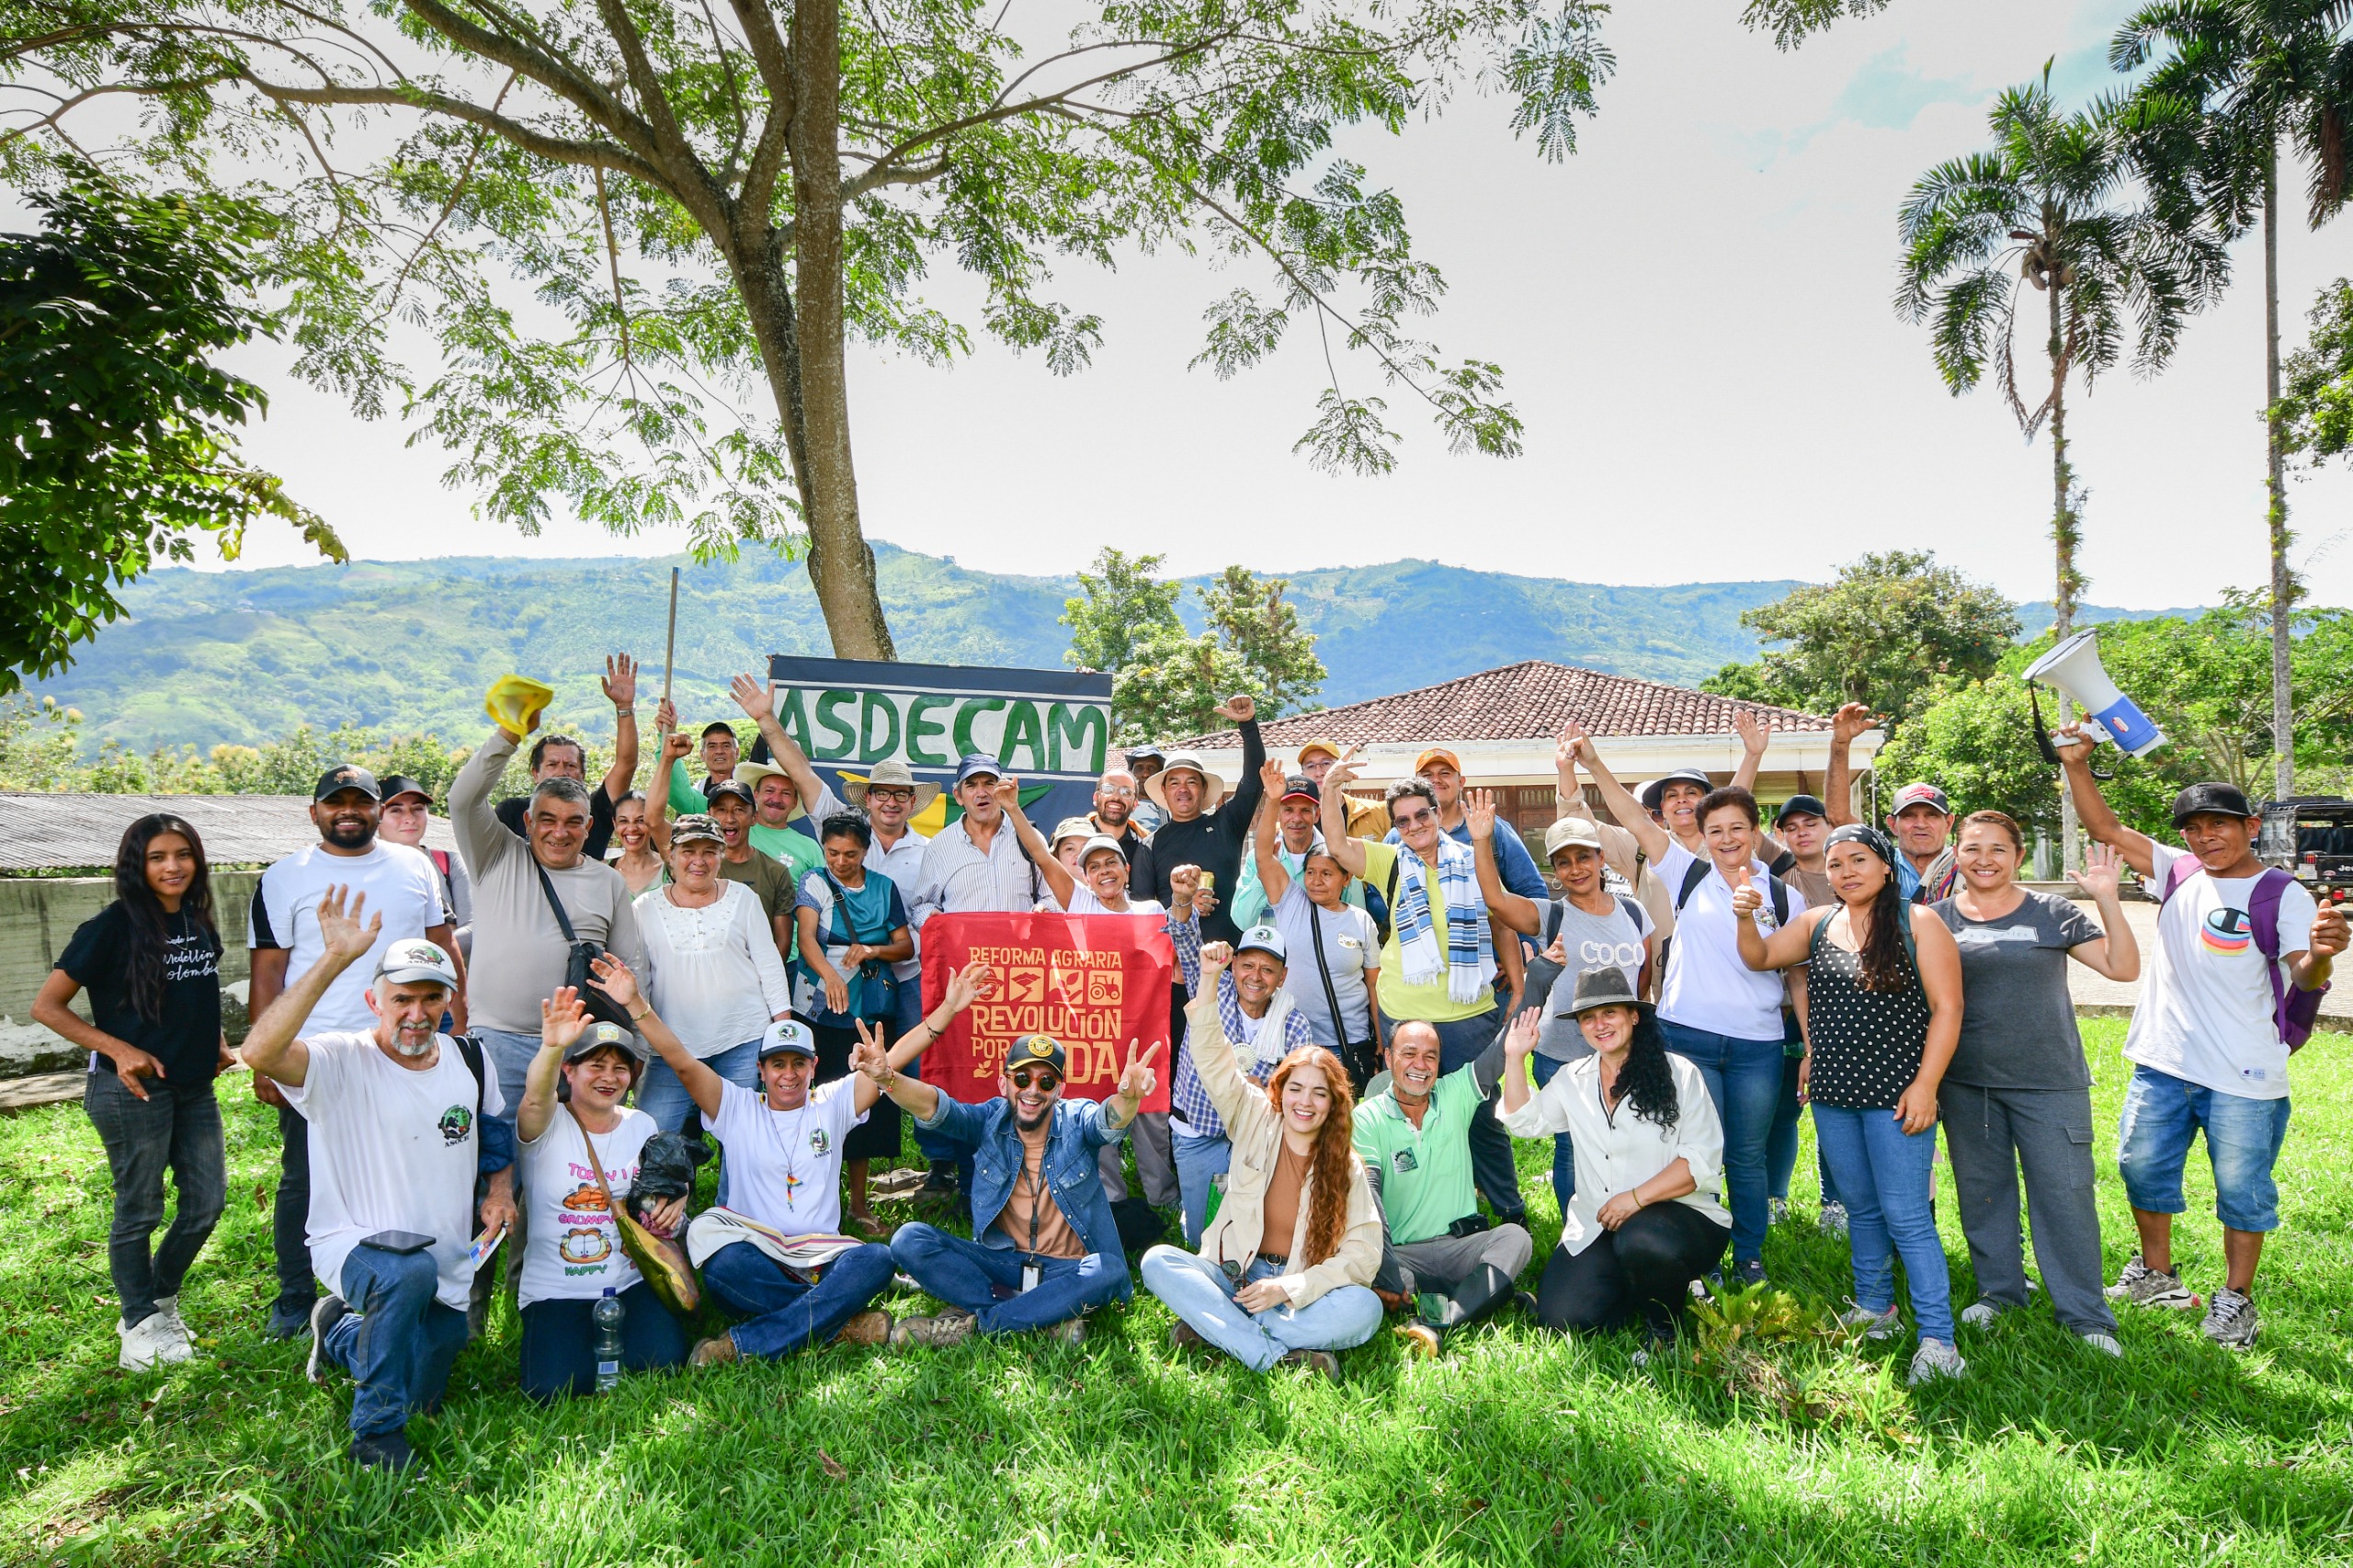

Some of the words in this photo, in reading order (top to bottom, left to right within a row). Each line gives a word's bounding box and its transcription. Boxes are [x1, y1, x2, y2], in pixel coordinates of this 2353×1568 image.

[779, 688, 1108, 772] ASDECAM
[969, 947, 1046, 965] REFORMA
[1051, 949, 1122, 968] AGRARIA
[1580, 940, 1646, 967] COCO
[970, 1005, 1121, 1040] REVOLUCIÓN
[971, 1037, 1010, 1059] POR
[568, 1163, 617, 1181] TODY
[559, 1213, 615, 1225] GRUMPY
[564, 1264, 608, 1277] HAPPY
